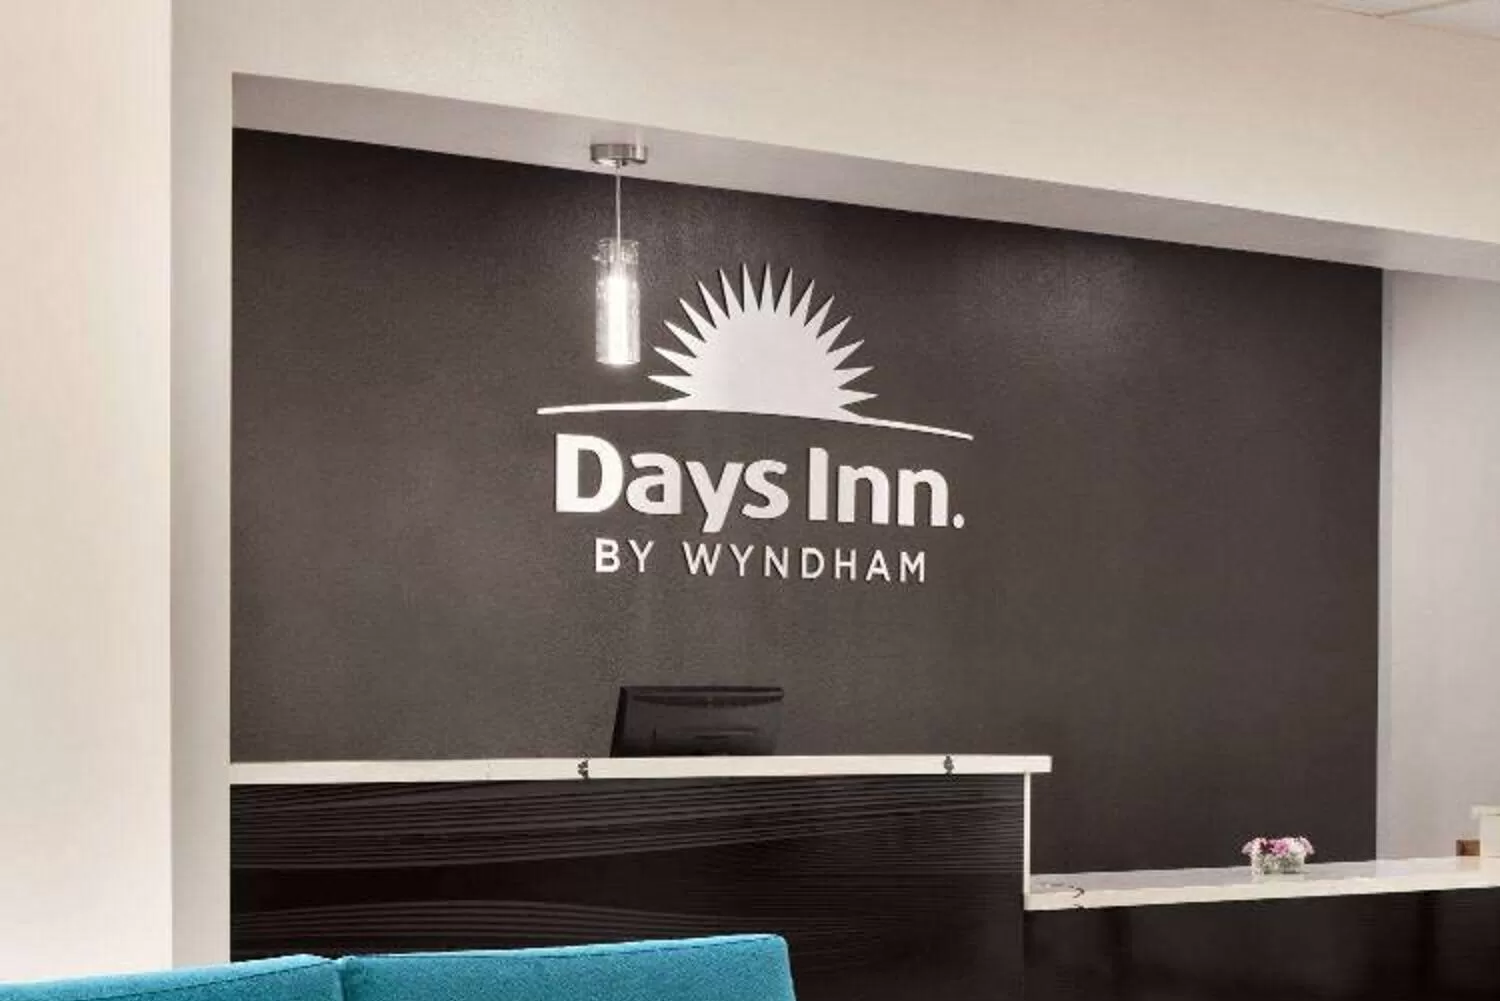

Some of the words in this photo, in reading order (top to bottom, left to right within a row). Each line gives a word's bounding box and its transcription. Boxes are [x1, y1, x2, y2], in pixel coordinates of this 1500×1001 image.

[555, 432, 791, 533] Days
[595, 537, 655, 573] BY
[682, 540, 926, 583] WYNDHAM
